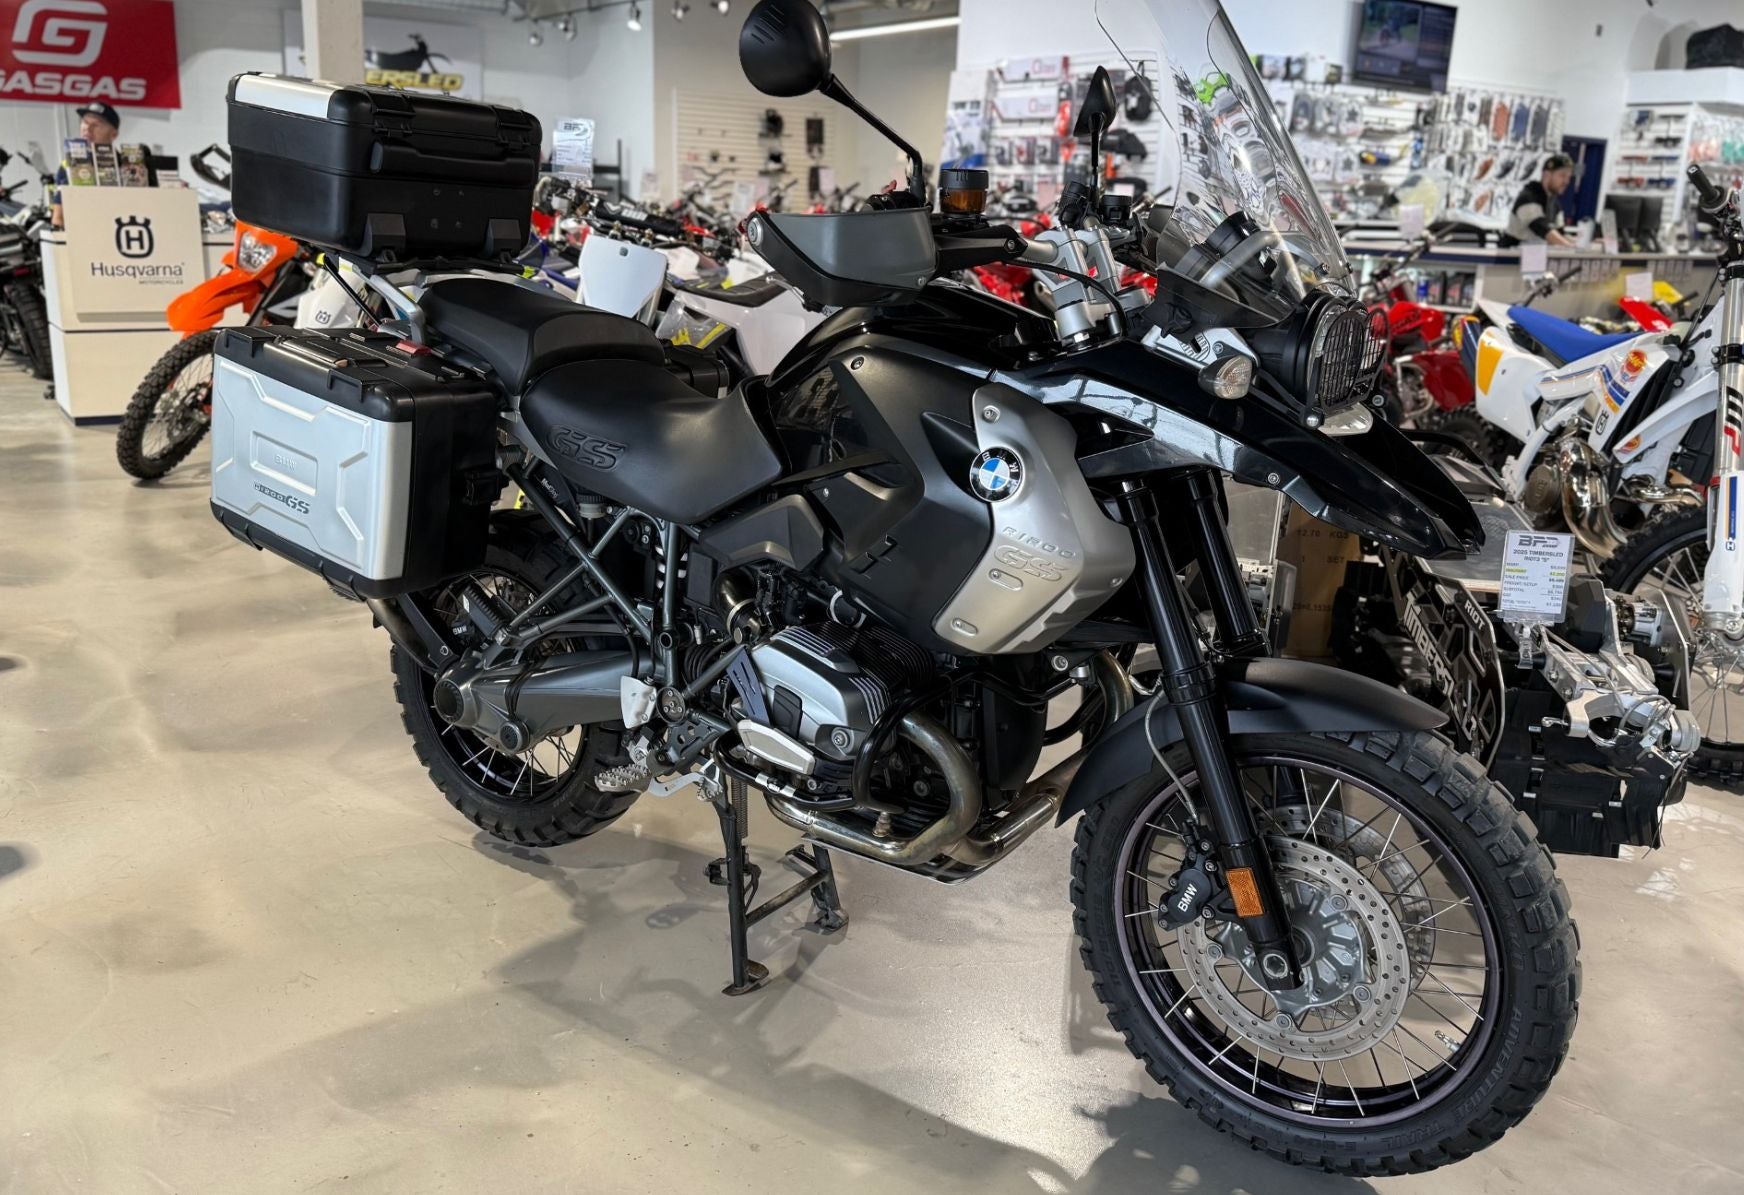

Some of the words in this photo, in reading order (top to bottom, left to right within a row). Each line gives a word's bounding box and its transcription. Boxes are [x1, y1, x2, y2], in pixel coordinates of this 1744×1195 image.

[0, 69, 147, 101] ASGAS
[364, 68, 464, 91] ERSLED
[91, 262, 184, 279] Husqvarna
[547, 425, 626, 470] GS
[994, 544, 1071, 582] GS
[1464, 600, 1486, 631] RIOT
[1177, 883, 1198, 913] BMW
